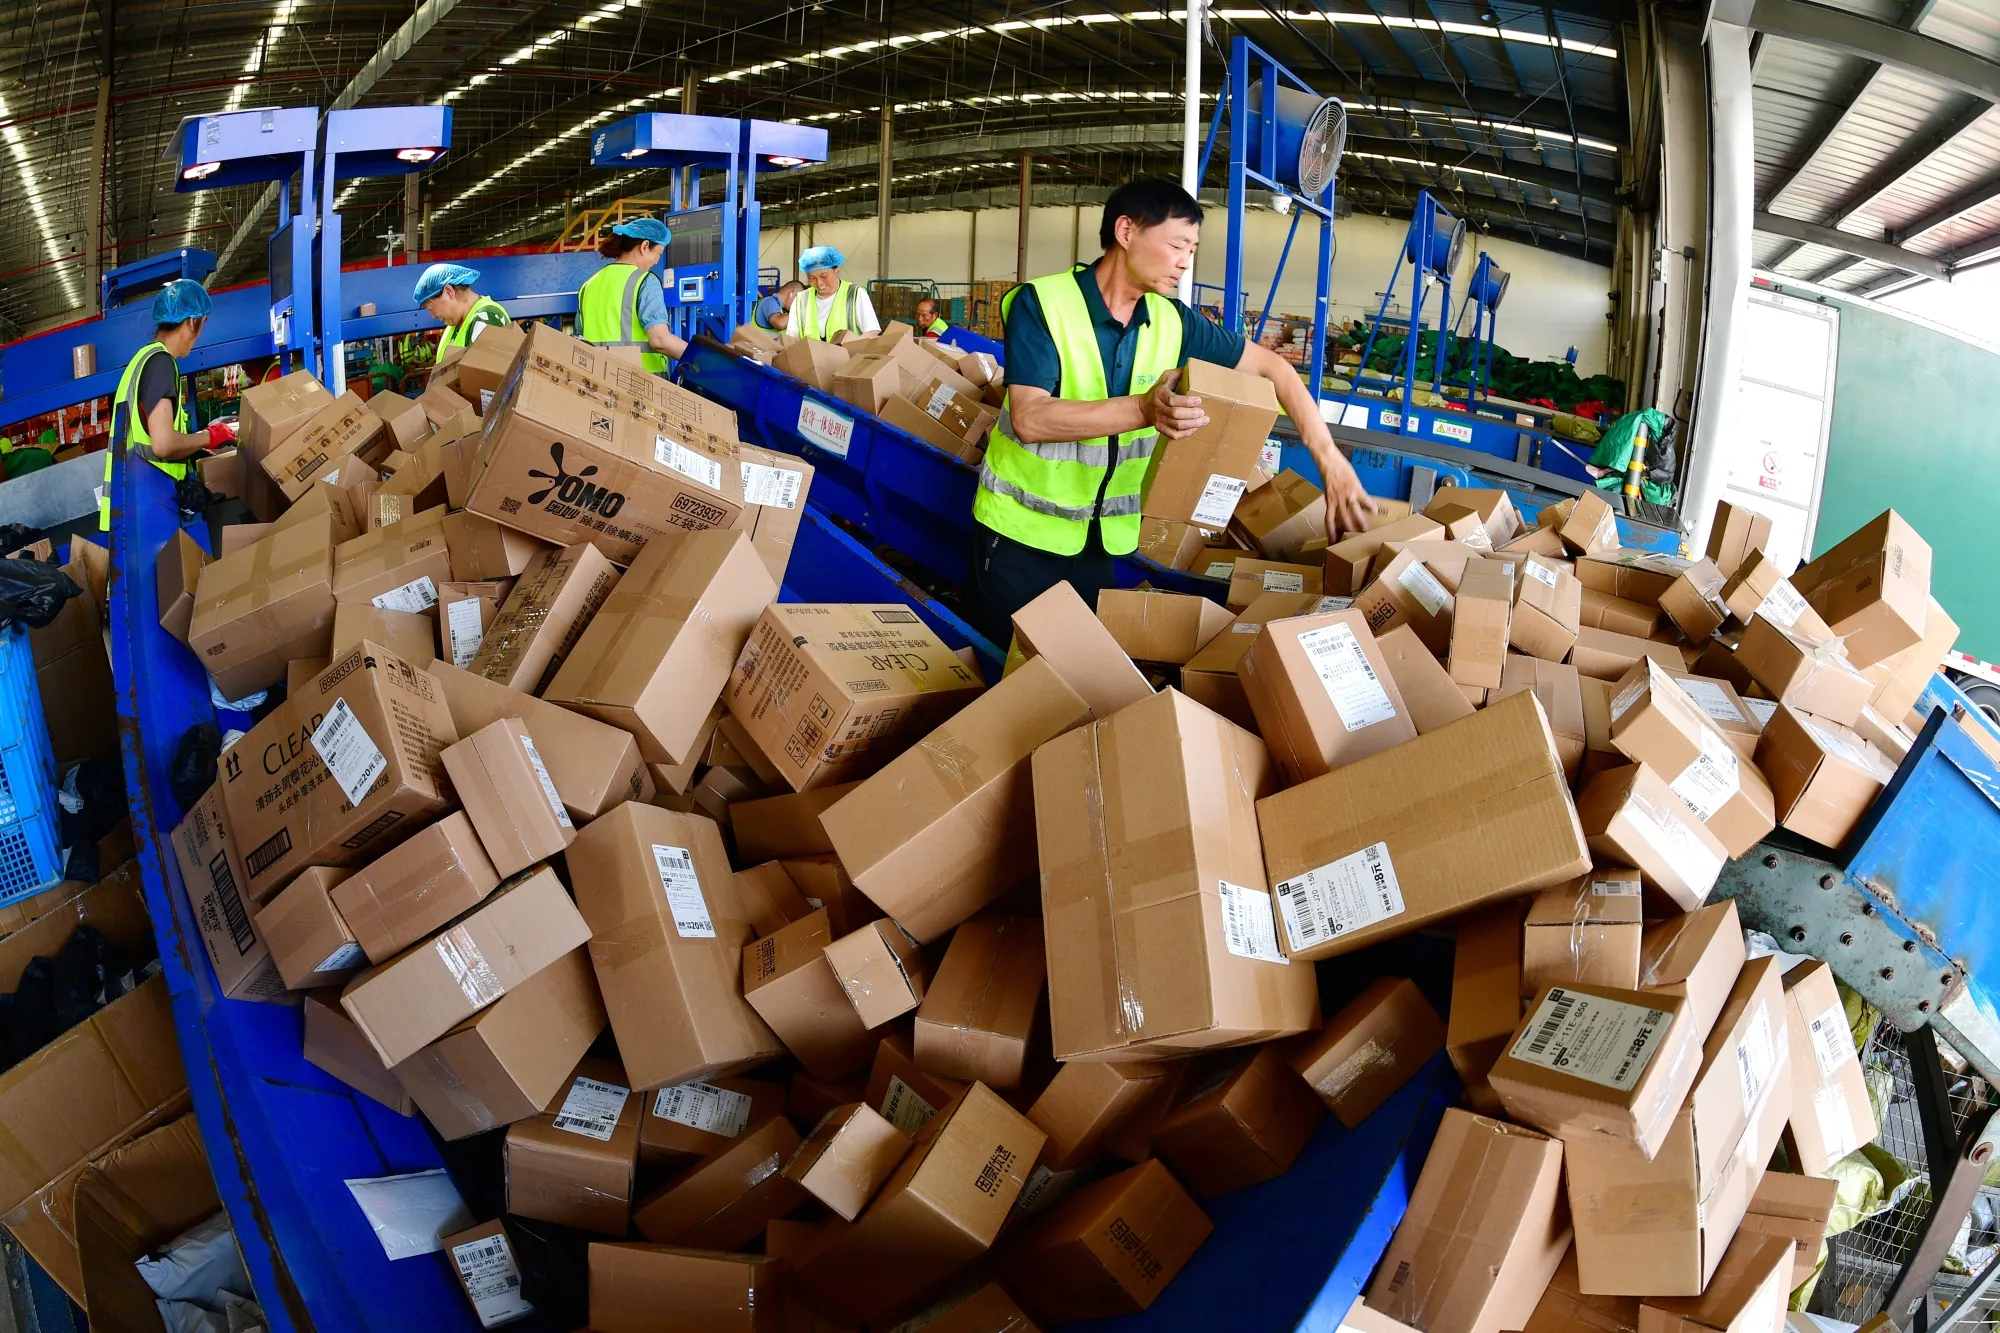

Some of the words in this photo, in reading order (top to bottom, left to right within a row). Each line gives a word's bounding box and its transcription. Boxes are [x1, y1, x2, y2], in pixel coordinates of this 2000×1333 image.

[543, 500, 581, 520] 奥妙
[557, 475, 626, 519] OMO
[675, 496, 723, 524] 69723937
[586, 571, 606, 604] 62738234
[321, 656, 362, 690] 69683319
[864, 653, 930, 672] CLEAR
[216, 822, 227, 840] P&G
[1548, 1001, 1589, 1057] 11E-11E-G50
